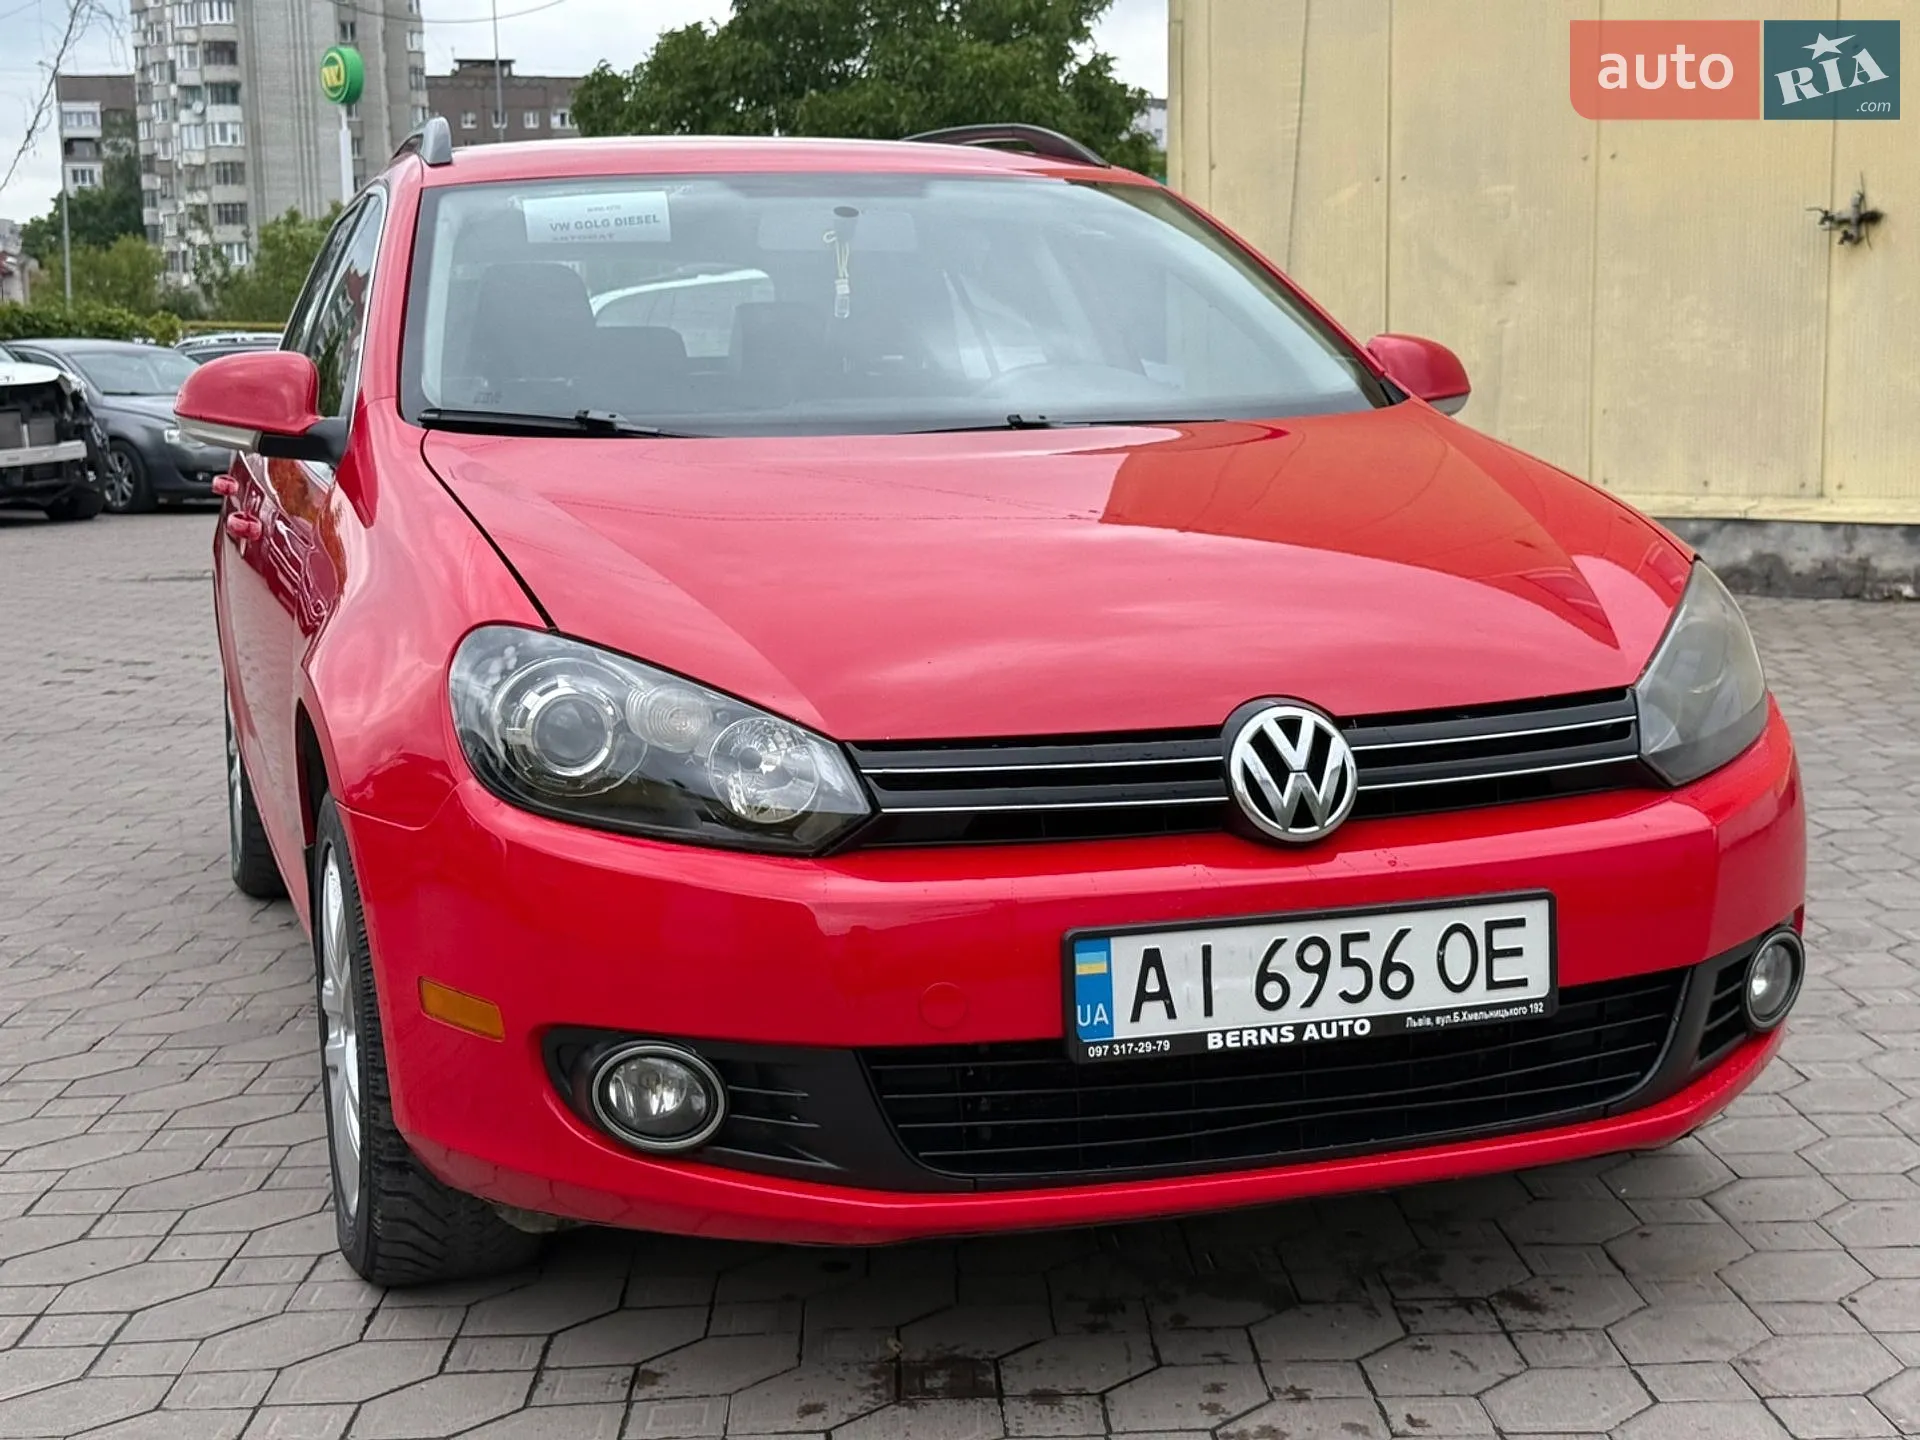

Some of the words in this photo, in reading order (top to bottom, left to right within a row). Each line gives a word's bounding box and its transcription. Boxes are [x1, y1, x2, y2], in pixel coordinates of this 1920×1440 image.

[550, 221, 570, 232] VW
[614, 214, 660, 227] DIESEL
[1130, 943, 1213, 1023] AI
[1254, 928, 1415, 1012] 6956
[1437, 918, 1528, 993] OE
[1077, 1004, 1109, 1026] UA
[1529, 1002, 1545, 1013] 192
[1207, 1026, 1295, 1050] BERNS
[1302, 1018, 1372, 1042] AUTO
[1088, 1046, 1109, 1058] 097
[1113, 1040, 1171, 1055] 317-29-79
